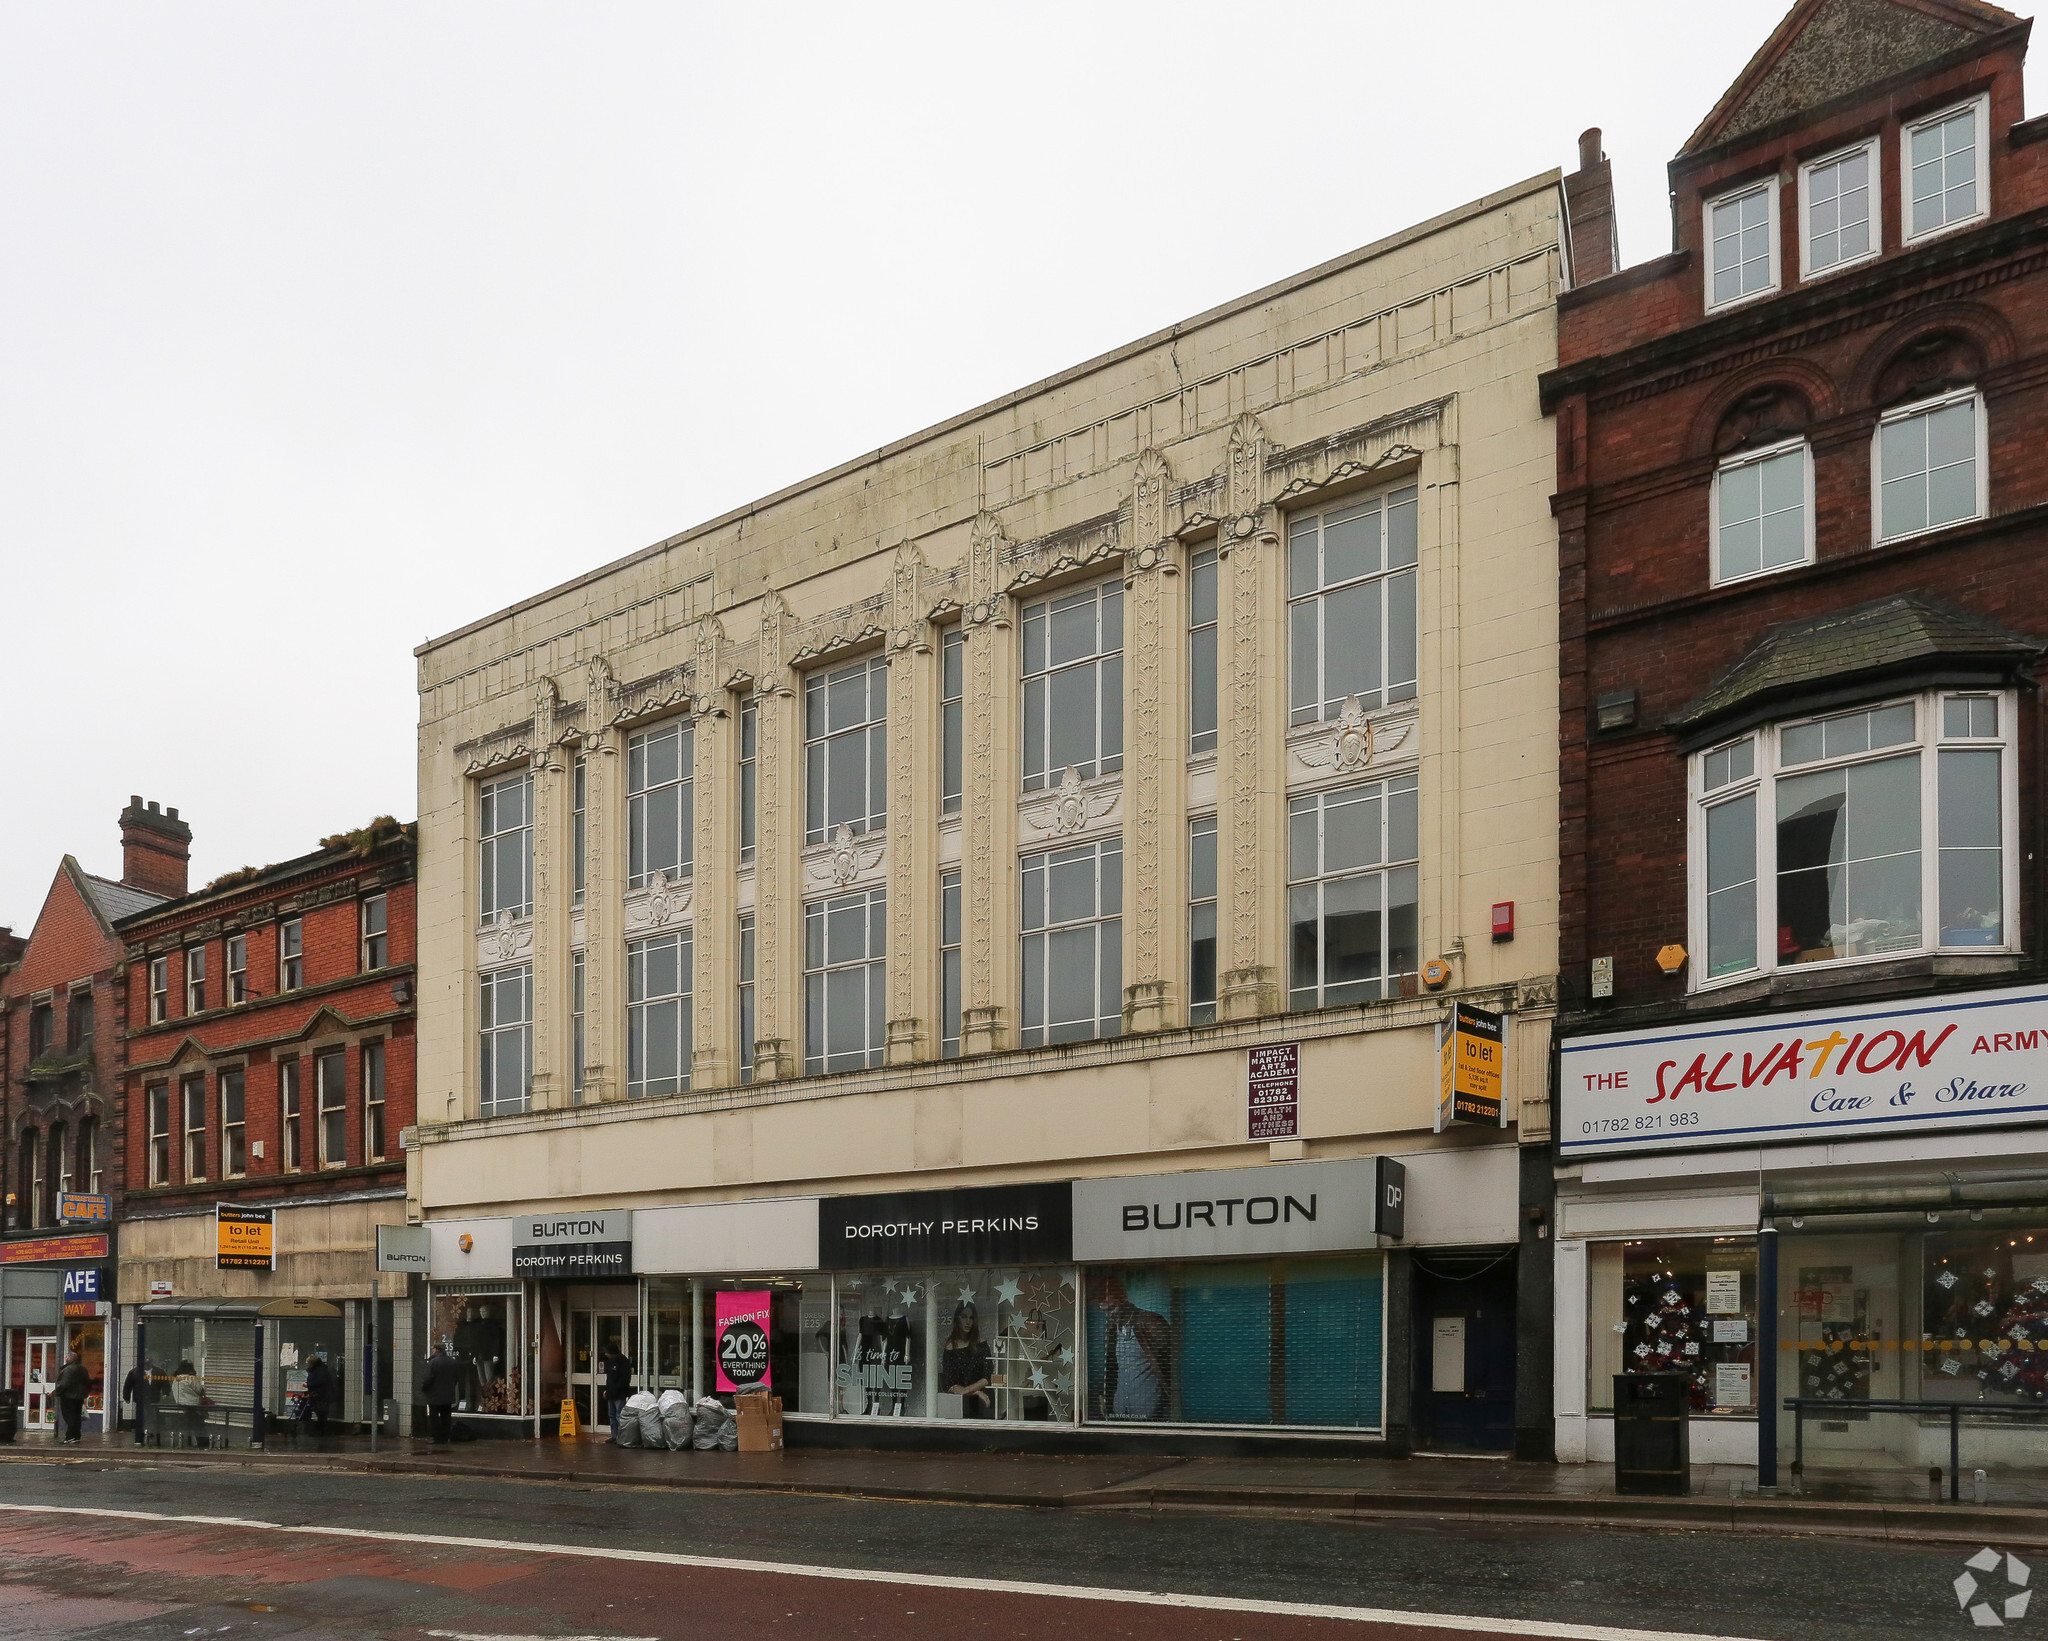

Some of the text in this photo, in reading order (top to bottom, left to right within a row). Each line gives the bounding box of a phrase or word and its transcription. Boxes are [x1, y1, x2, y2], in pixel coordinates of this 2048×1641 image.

[1458, 1013, 1497, 1032] butters john bee
[1256, 1048, 1291, 1058] IMPACT
[1466, 1039, 1493, 1062] to let
[1251, 1054, 1295, 1065] MARTIAL
[1583, 1071, 1629, 1092] THE
[1646, 1024, 1958, 1104] SALVATION
[1261, 1062, 1286, 1071] ARTS
[1250, 1068, 1297, 1079] ACADEMY
[1476, 1067, 1486, 1076] floor
[1486, 1070, 1500, 1079] offices
[1253, 1080, 1294, 1089] TELEPHONE
[1469, 1083, 1478, 1091] may
[1258, 1088, 1288, 1097] 01782
[1810, 1077, 2029, 1113] Care & Share
[1254, 1095, 1292, 1104] 823984
[1253, 1106, 1292, 1116] HEALTH
[1456, 1100, 1476, 1114] 01782
[1476, 1104, 1499, 1118] 212201
[1263, 1114, 1283, 1122] AND
[1582, 1111, 1700, 1134] 01782 821 983
[1252, 1120, 1294, 1129] FITNESS
[1253, 1127, 1293, 1136] CENTRE
[1387, 1184, 1402, 1209] DP
[63, 1202, 107, 1219] CAFE
[1122, 1194, 1317, 1231] BURTON
[229, 1225, 262, 1236] to let
[532, 1220, 605, 1237] BURTON
[845, 1216, 1039, 1239] DOROTHY PERKINS
[386, 1253, 426, 1262] BURTON
[516, 1254, 623, 1267] DOROTHY PERKINS
[718, 1309, 770, 1327] FASHION FIX
[804, 1319, 821, 1328] £25
[721, 1333, 767, 1360] 20%
[865, 1347, 887, 1361] time
[889, 1348, 900, 1362] to
[732, 1369, 756, 1377] TODAY
[835, 1363, 913, 1390] SHINE
[878, 1391, 908, 1399] COLLECTION
